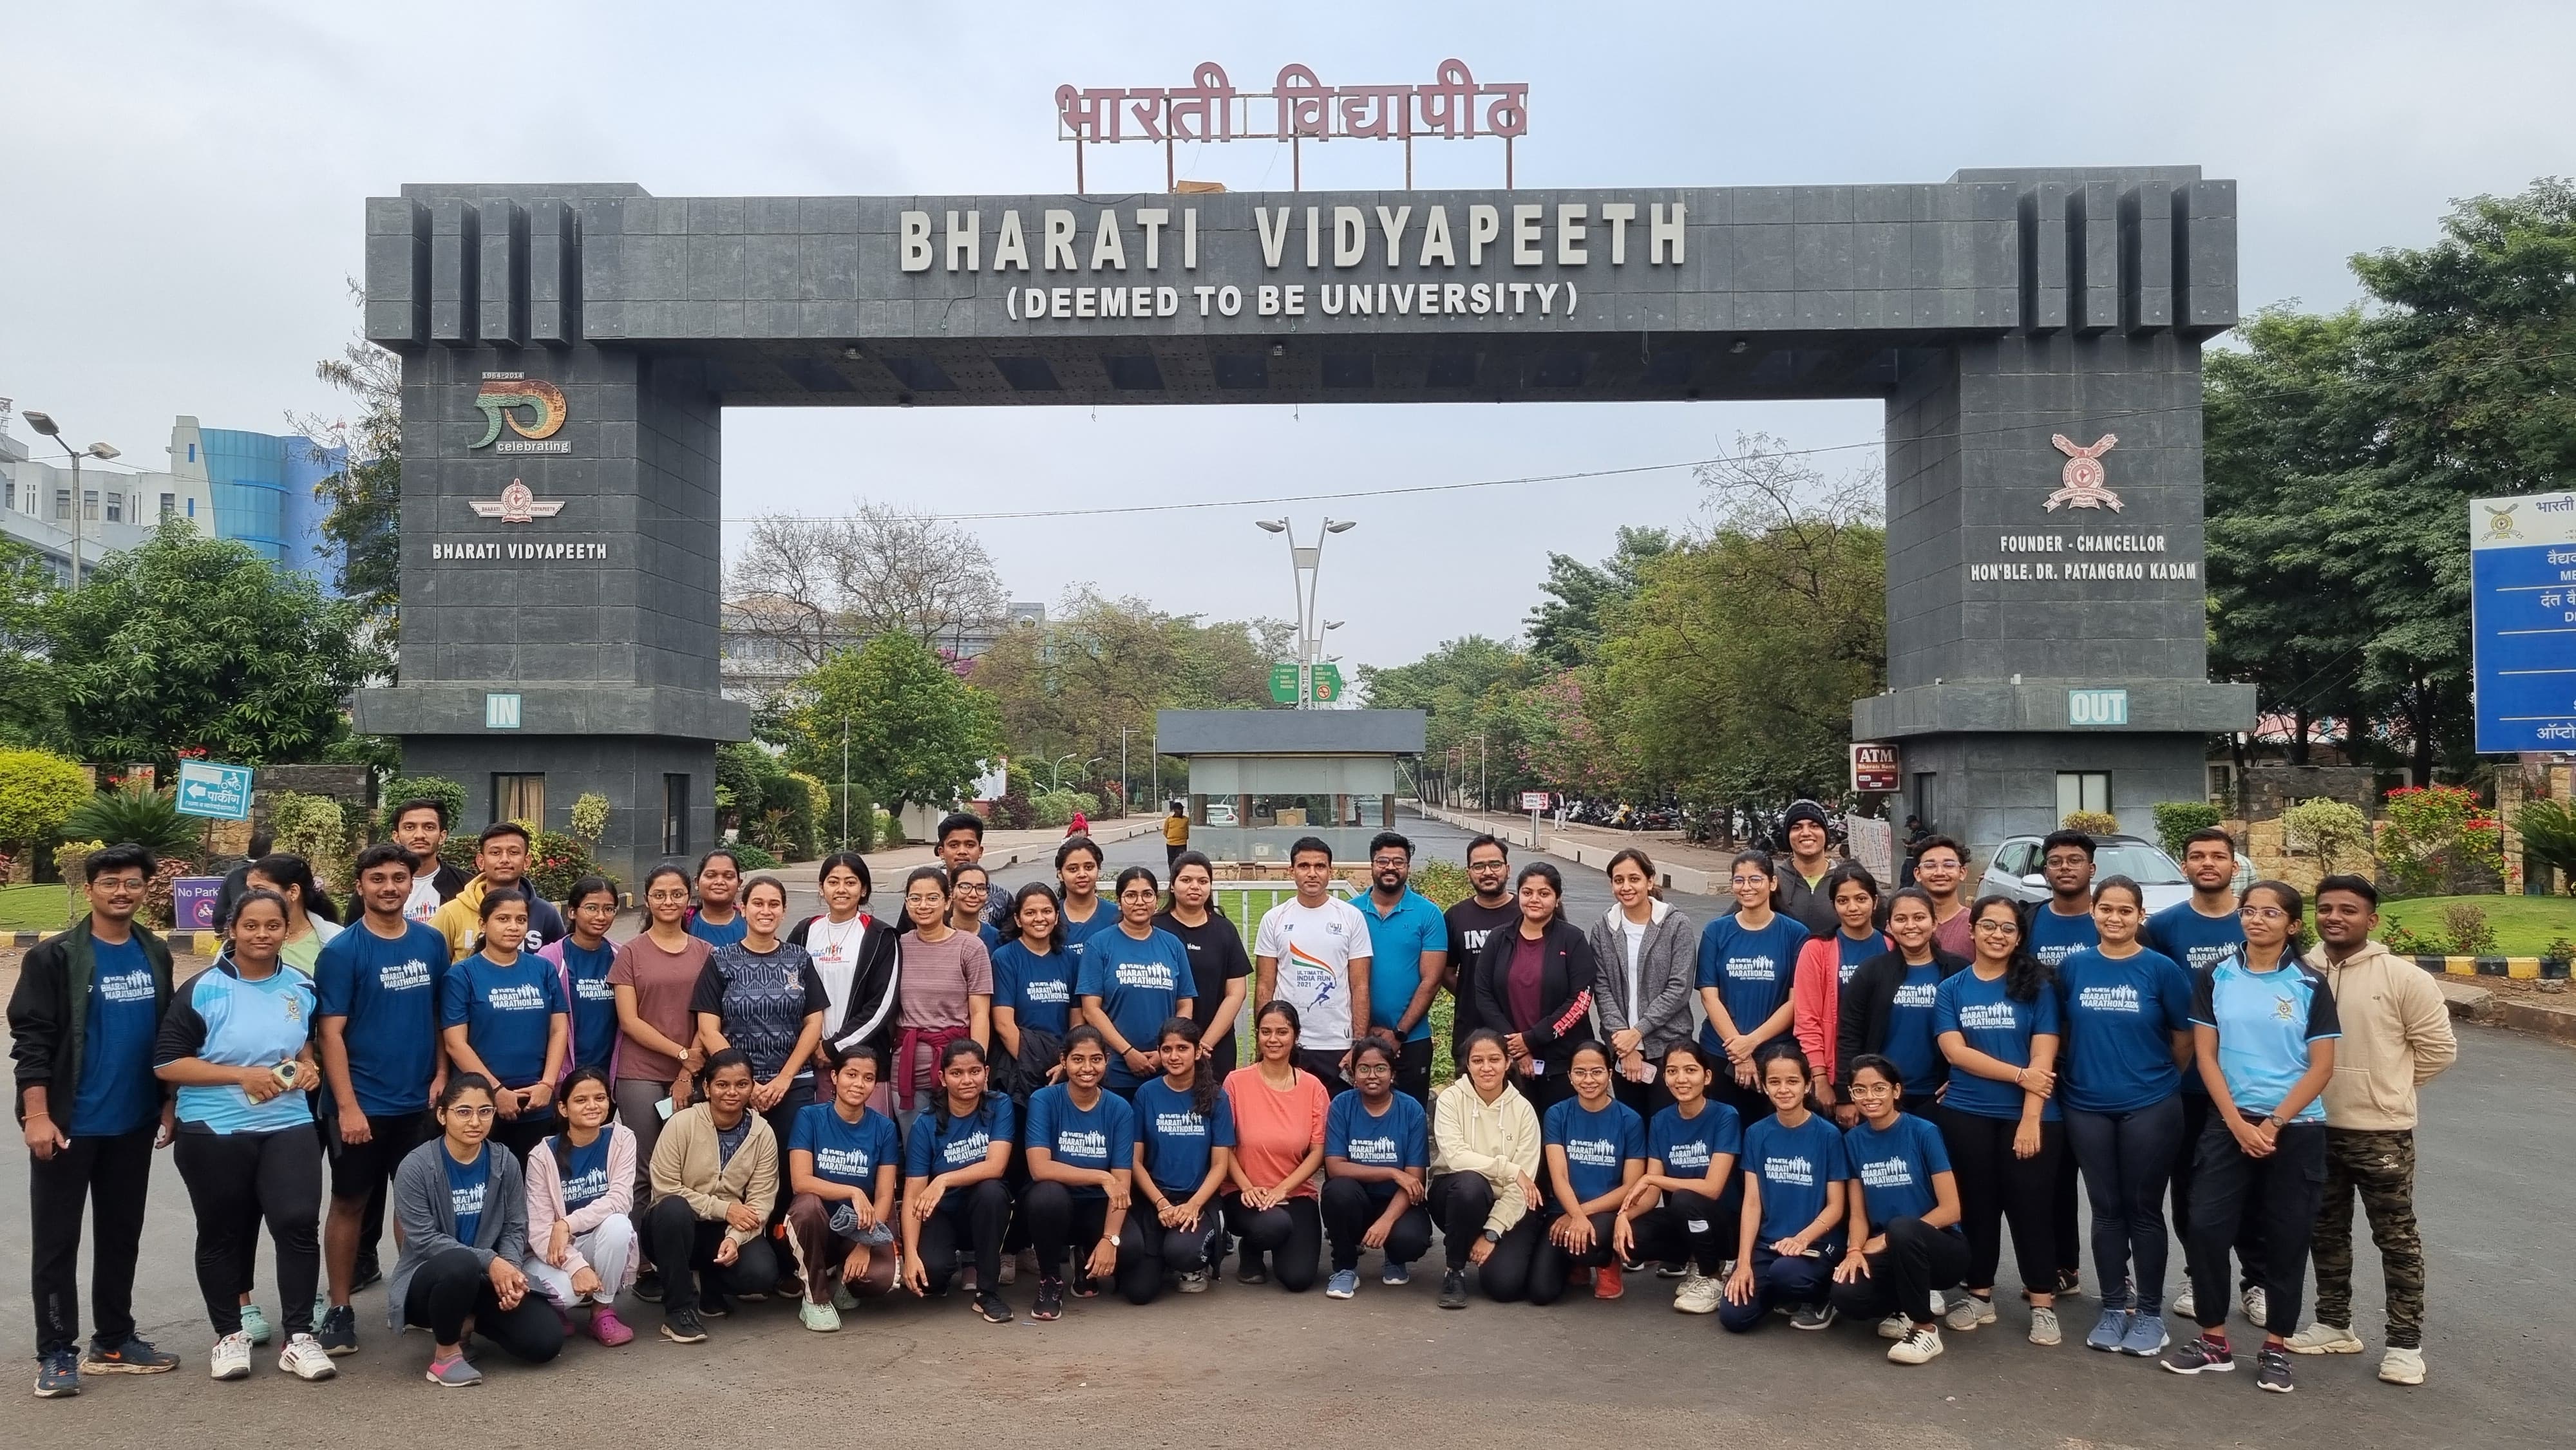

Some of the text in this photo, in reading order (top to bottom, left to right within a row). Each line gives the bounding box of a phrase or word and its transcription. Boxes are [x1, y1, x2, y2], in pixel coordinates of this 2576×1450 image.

[1056, 59, 1528, 144] भारती विद्यापीठ
[901, 203, 1685, 272] BHARATI VIDYAPEETH
[1007, 281, 1577, 320] (DEEMED TO BE UNIVERSITY)
[497, 441, 569, 453] celebrating
[2536, 496, 2575, 513] भारती
[2000, 536, 2062, 552] FOUNDER
[2077, 535, 2164, 552] CHANCELLOR
[433, 543, 607, 559] BHARATI VIDYAPEETH
[1971, 563, 2196, 580] HON'BLE. DR. PATANGRAO KADAM
[2540, 591, 2561, 607] दंत
[489, 697, 517, 724] IN
[2072, 693, 2125, 722] OUT
[1860, 749, 1893, 762] ATM
[178, 887, 220, 897] No Park
[1464, 930, 1492, 949] IN
[2186, 953, 2219, 961] BHARATI
[380, 971, 405, 981] BHARATI
[1116, 970, 1147, 978] BHARATI
[384, 977, 418, 989] MARATHON
[1120, 976, 1162, 985] MARATHON
[101, 983, 128, 992] BHARATI
[105, 988, 143, 999] MARATHON
[489, 993, 519, 1002] BHARATI
[1030, 992, 1062, 1001] MARATHON
[493, 997, 532, 1009] MARATHON
[2081, 999, 2123, 1008] MARATHON
[1960, 1011, 1987, 1021] BHARATI
[1962, 1017, 2000, 1028] MARATHON
[1059, 1136, 1084, 1146] BHARATI
[943, 1144, 970, 1157] BHARATI
[1060, 1145, 1095, 1154] MARATHON
[1566, 1145, 1594, 1154] BHARATI
[817, 1153, 846, 1164] BHARATI
[947, 1148, 981, 1163] MARATHON
[1569, 1153, 1604, 1162] MARATHON
[819, 1162, 857, 1173] MARATHON
[1765, 1163, 1788, 1172] BHARATI
[1861, 1168, 1887, 1178] BHARATI
[1766, 1171, 1799, 1180] MARATHON
[1863, 1174, 1898, 1185] MARATHON
[452, 1196, 470, 1204] ARATI
